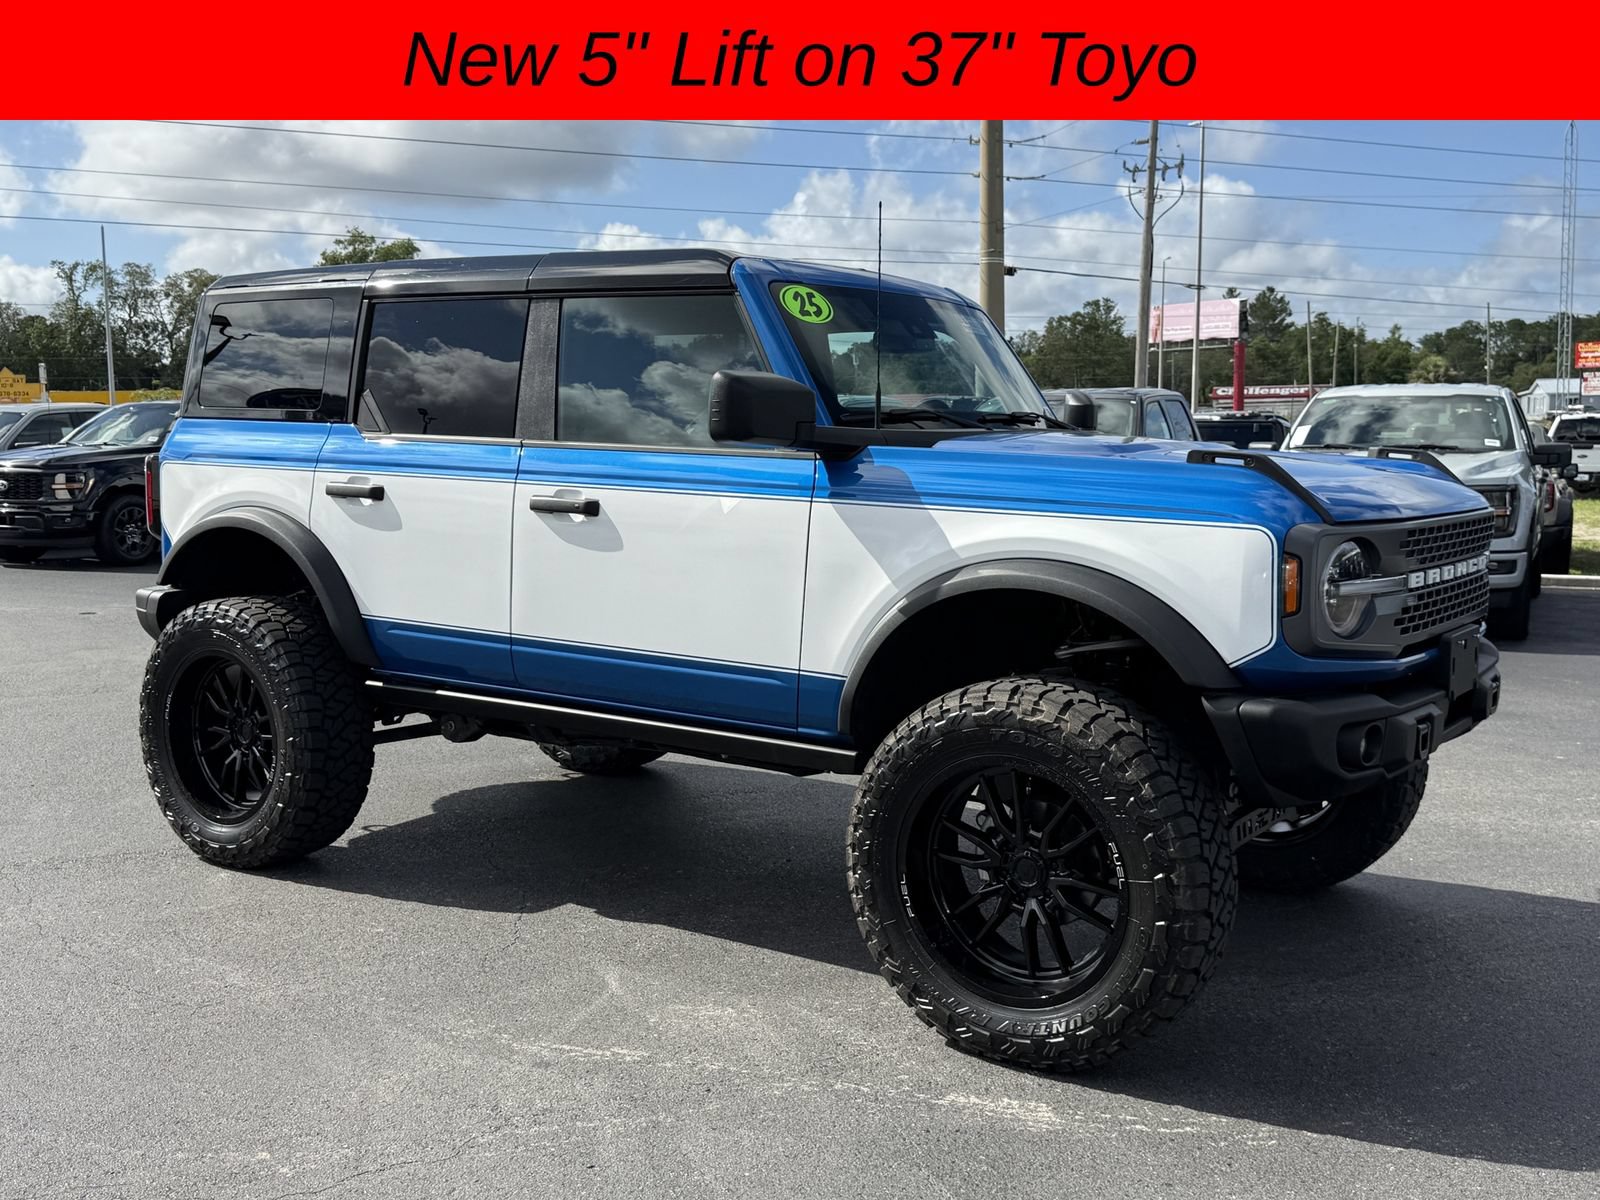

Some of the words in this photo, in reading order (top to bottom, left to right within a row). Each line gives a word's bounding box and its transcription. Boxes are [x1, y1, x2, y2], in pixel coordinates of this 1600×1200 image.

[792, 291, 823, 318] 25
[1216, 387, 1309, 396] Cllenger
[1408, 555, 1487, 589] BRONCO
[1108, 842, 1125, 890] FUEL
[900, 872, 915, 918] FUEL
[996, 994, 1112, 1036] COUNTRY
